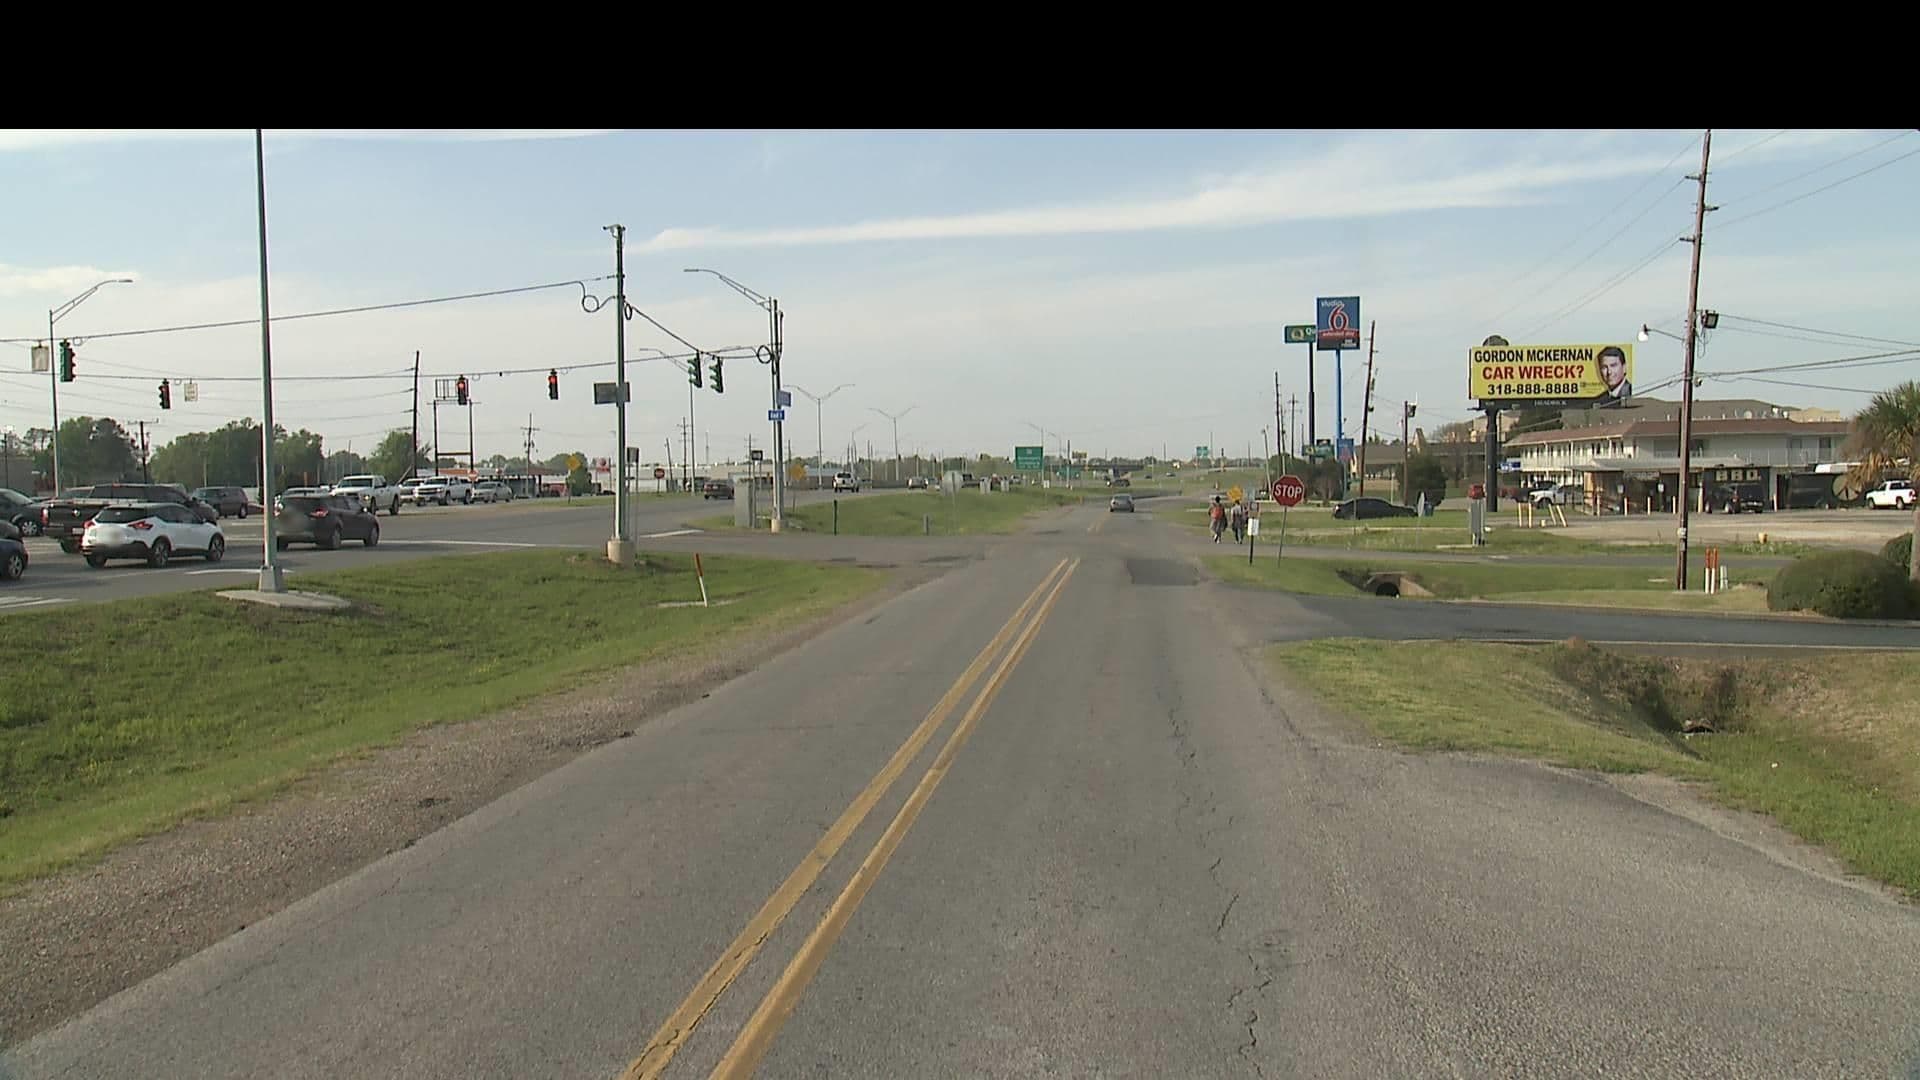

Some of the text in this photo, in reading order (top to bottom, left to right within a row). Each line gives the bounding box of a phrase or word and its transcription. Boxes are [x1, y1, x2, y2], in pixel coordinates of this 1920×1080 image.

[1328, 303, 1349, 330] 6
[1474, 348, 1593, 363] GORDON MCKERNAN
[1482, 365, 1585, 380] CAR WRECK?
[1487, 382, 1579, 396] 318-888-8888
[1274, 484, 1302, 499] STOP
